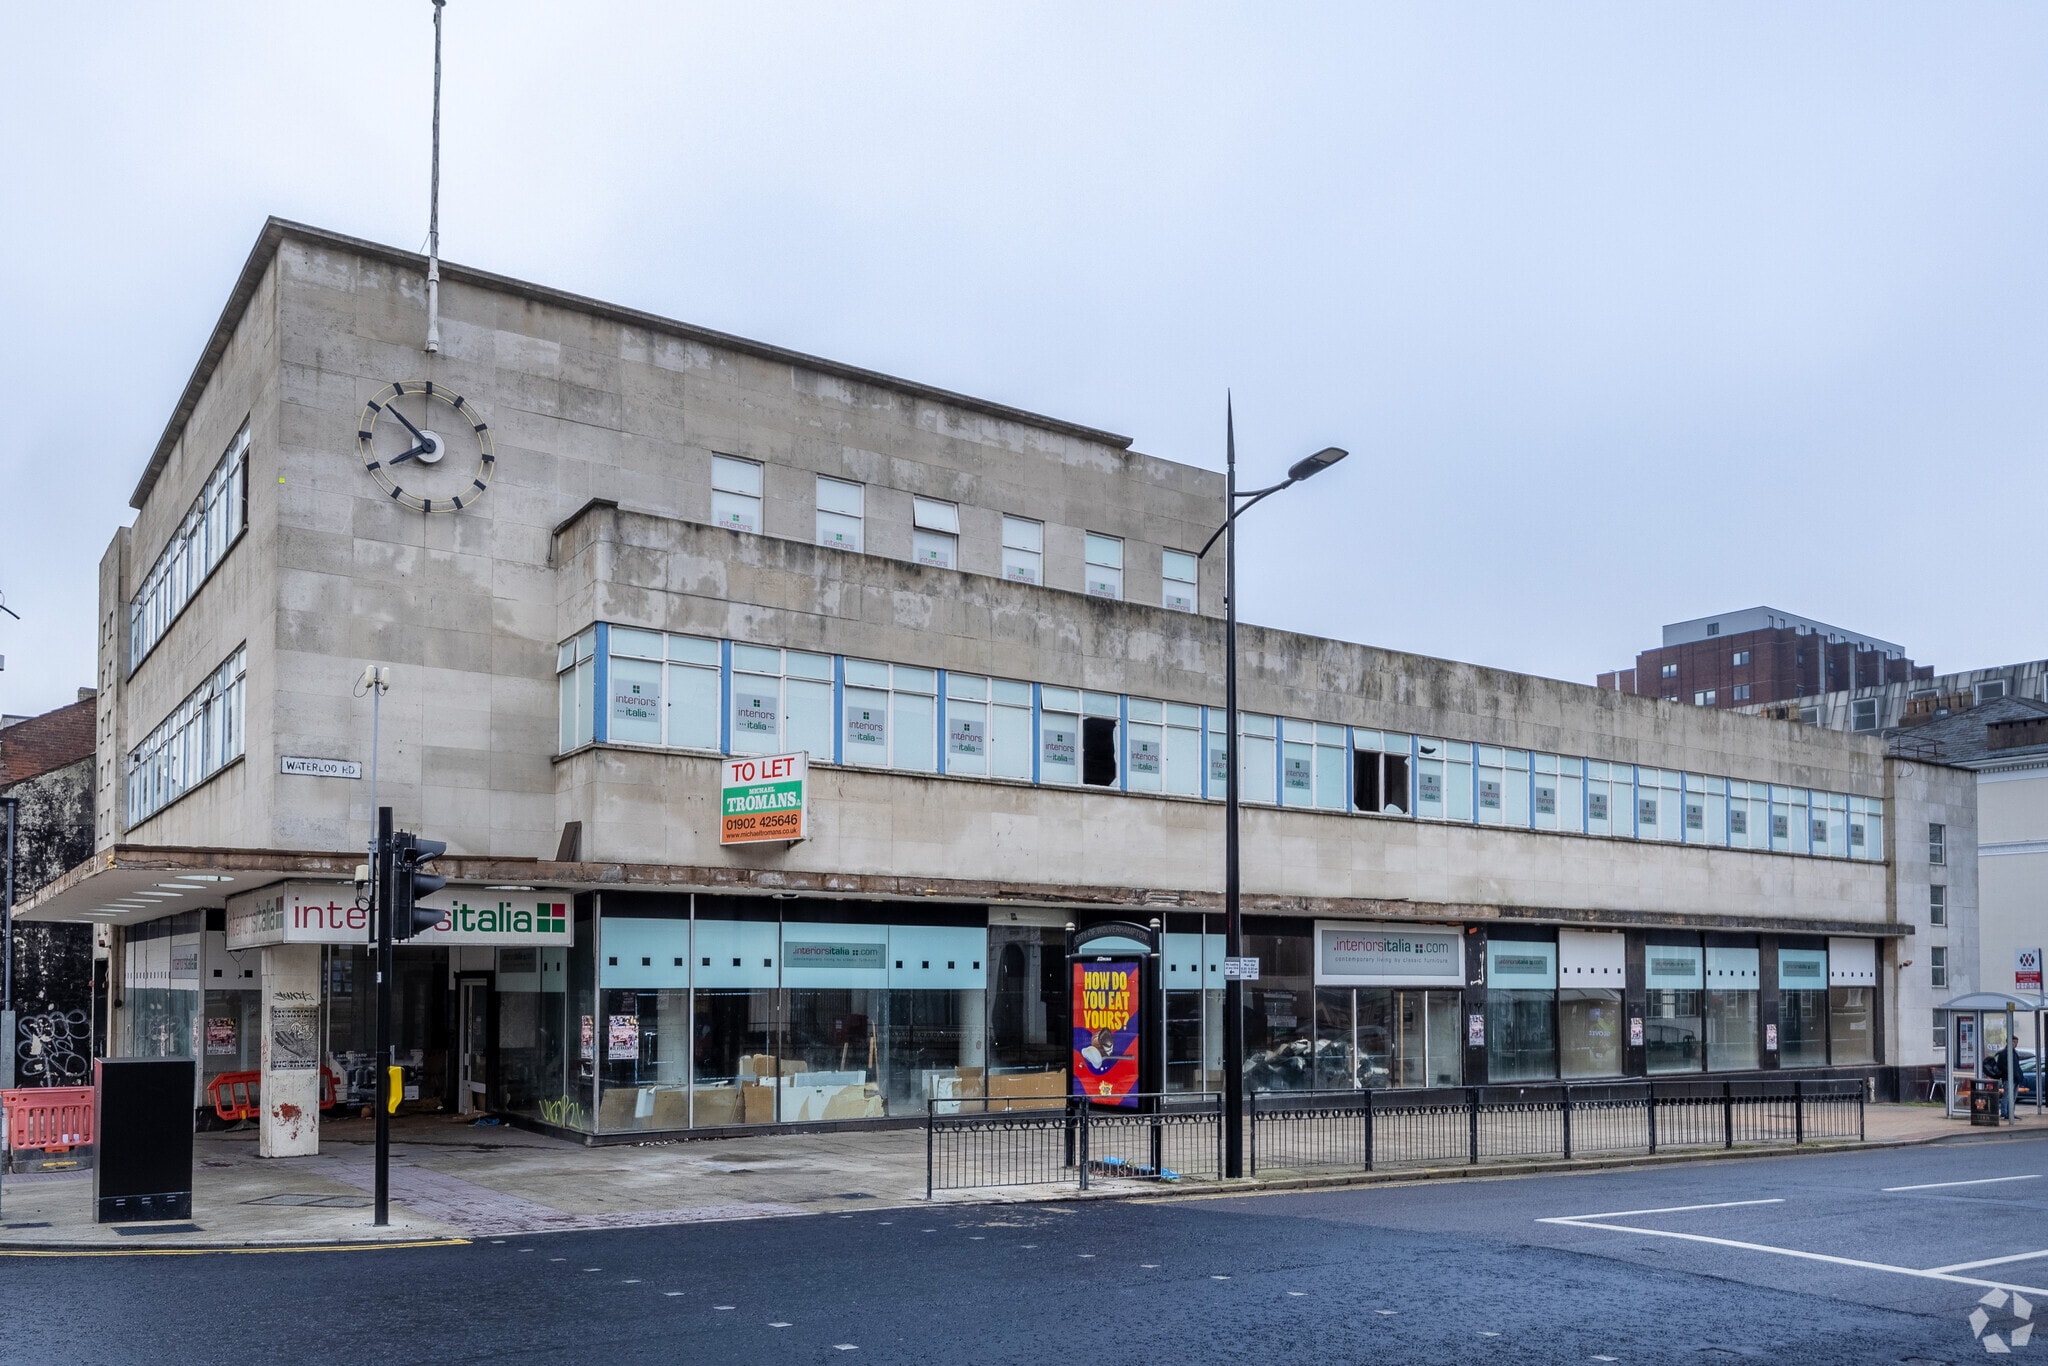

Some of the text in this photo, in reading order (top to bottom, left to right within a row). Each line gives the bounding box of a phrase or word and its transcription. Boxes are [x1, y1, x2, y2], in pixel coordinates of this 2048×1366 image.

[719, 520, 753, 531] interiors
[824, 539, 854, 550] interiors
[919, 556, 948, 567] interiors
[1008, 574, 1034, 584] interiors
[1090, 588, 1115, 598] interiors
[616, 693, 656, 707] interiors
[625, 706, 647, 718] italia
[738, 707, 775, 720] interiors
[747, 720, 767, 730] italia
[849, 720, 883, 732] interiors
[857, 732, 876, 742] italia
[951, 731, 983, 743] interiors
[958, 742, 976, 752] italia
[1045, 743, 1075, 753] interiors
[1052, 753, 1068, 762] italia
[1131, 753, 1159, 762] interiors
[1211, 759, 1225, 768] inter
[286, 761, 355, 775] WATERLOO RD
[731, 757, 795, 782] TO LET
[1137, 762, 1153, 770] italia
[748, 786, 775, 795] MICHAEL
[727, 791, 797, 813] TROMANS
[726, 814, 798, 831] 01902 425646
[726, 827, 797, 839] www.michaeltromans.co.uk
[294, 897, 532, 933] intesitalia
[1075, 925, 1149, 943] CITY OF WOLVERHAMPTON
[1084, 971, 1128, 990] HOW DO
[1083, 991, 1130, 1010] YOU EAT
[1083, 1010, 1130, 1030] YOURS?
